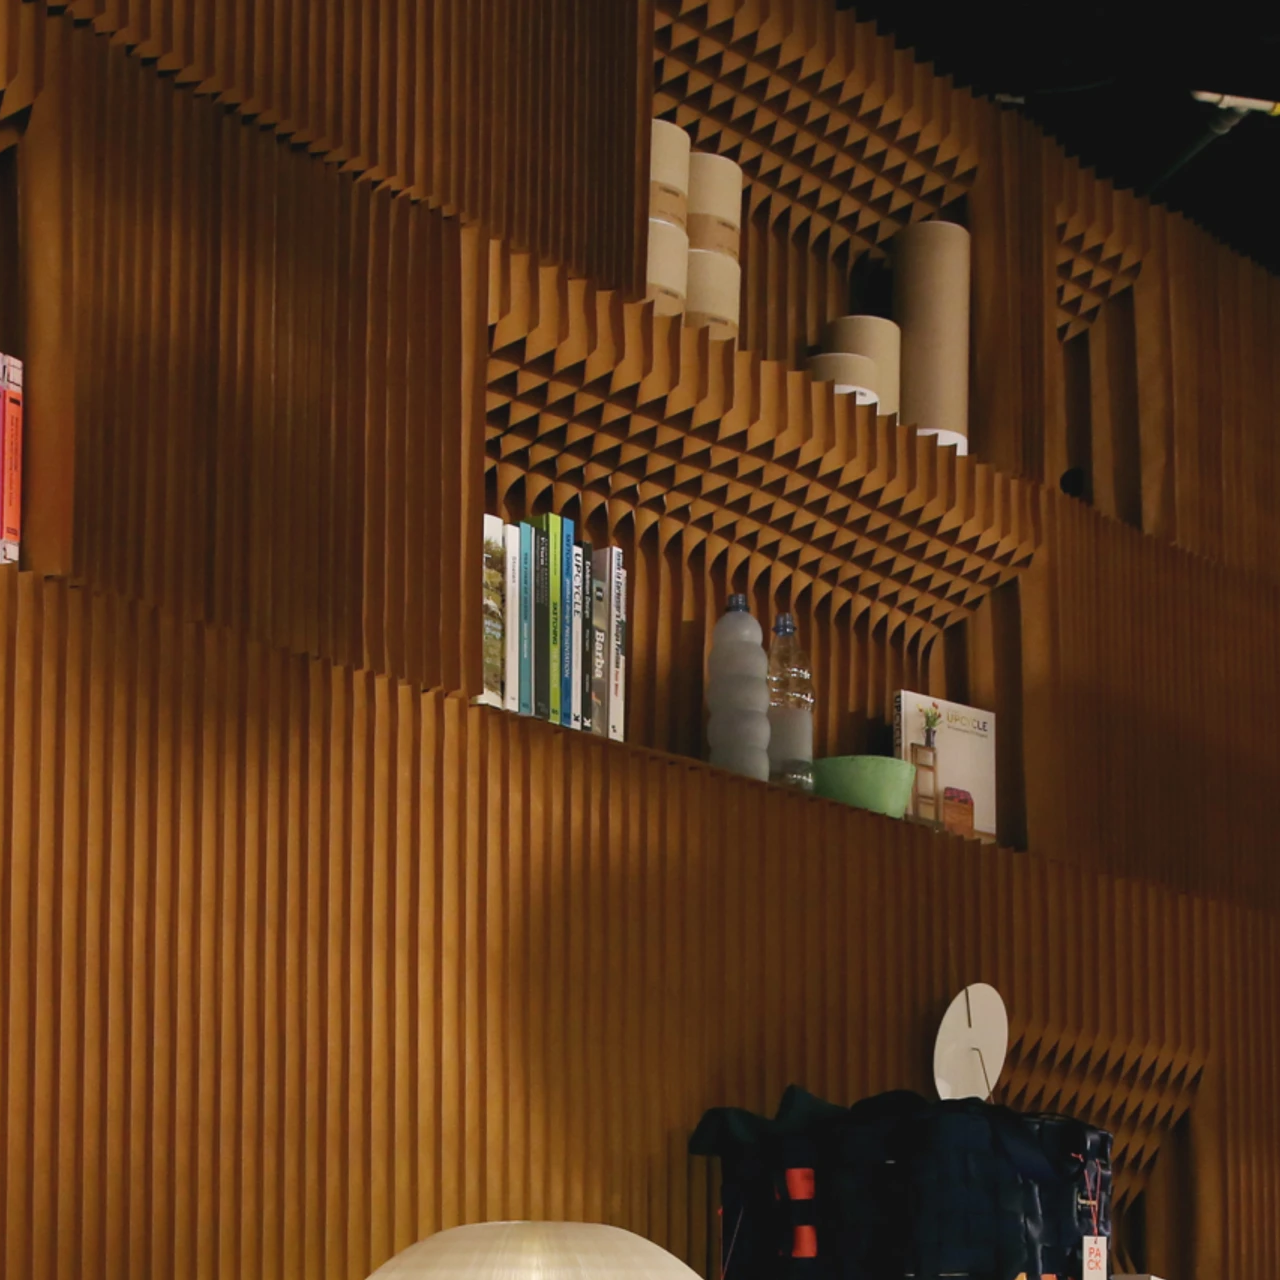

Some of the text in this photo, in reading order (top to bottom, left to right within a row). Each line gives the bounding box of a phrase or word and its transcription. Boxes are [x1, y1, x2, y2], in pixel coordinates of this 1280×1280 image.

[573, 553, 582, 617] UPCYCLE
[594, 630, 605, 678] Barba
[946, 709, 988, 732] UPCYCLE
[1088, 1246, 1102, 1259] PA
[1087, 1259, 1102, 1271] CK
